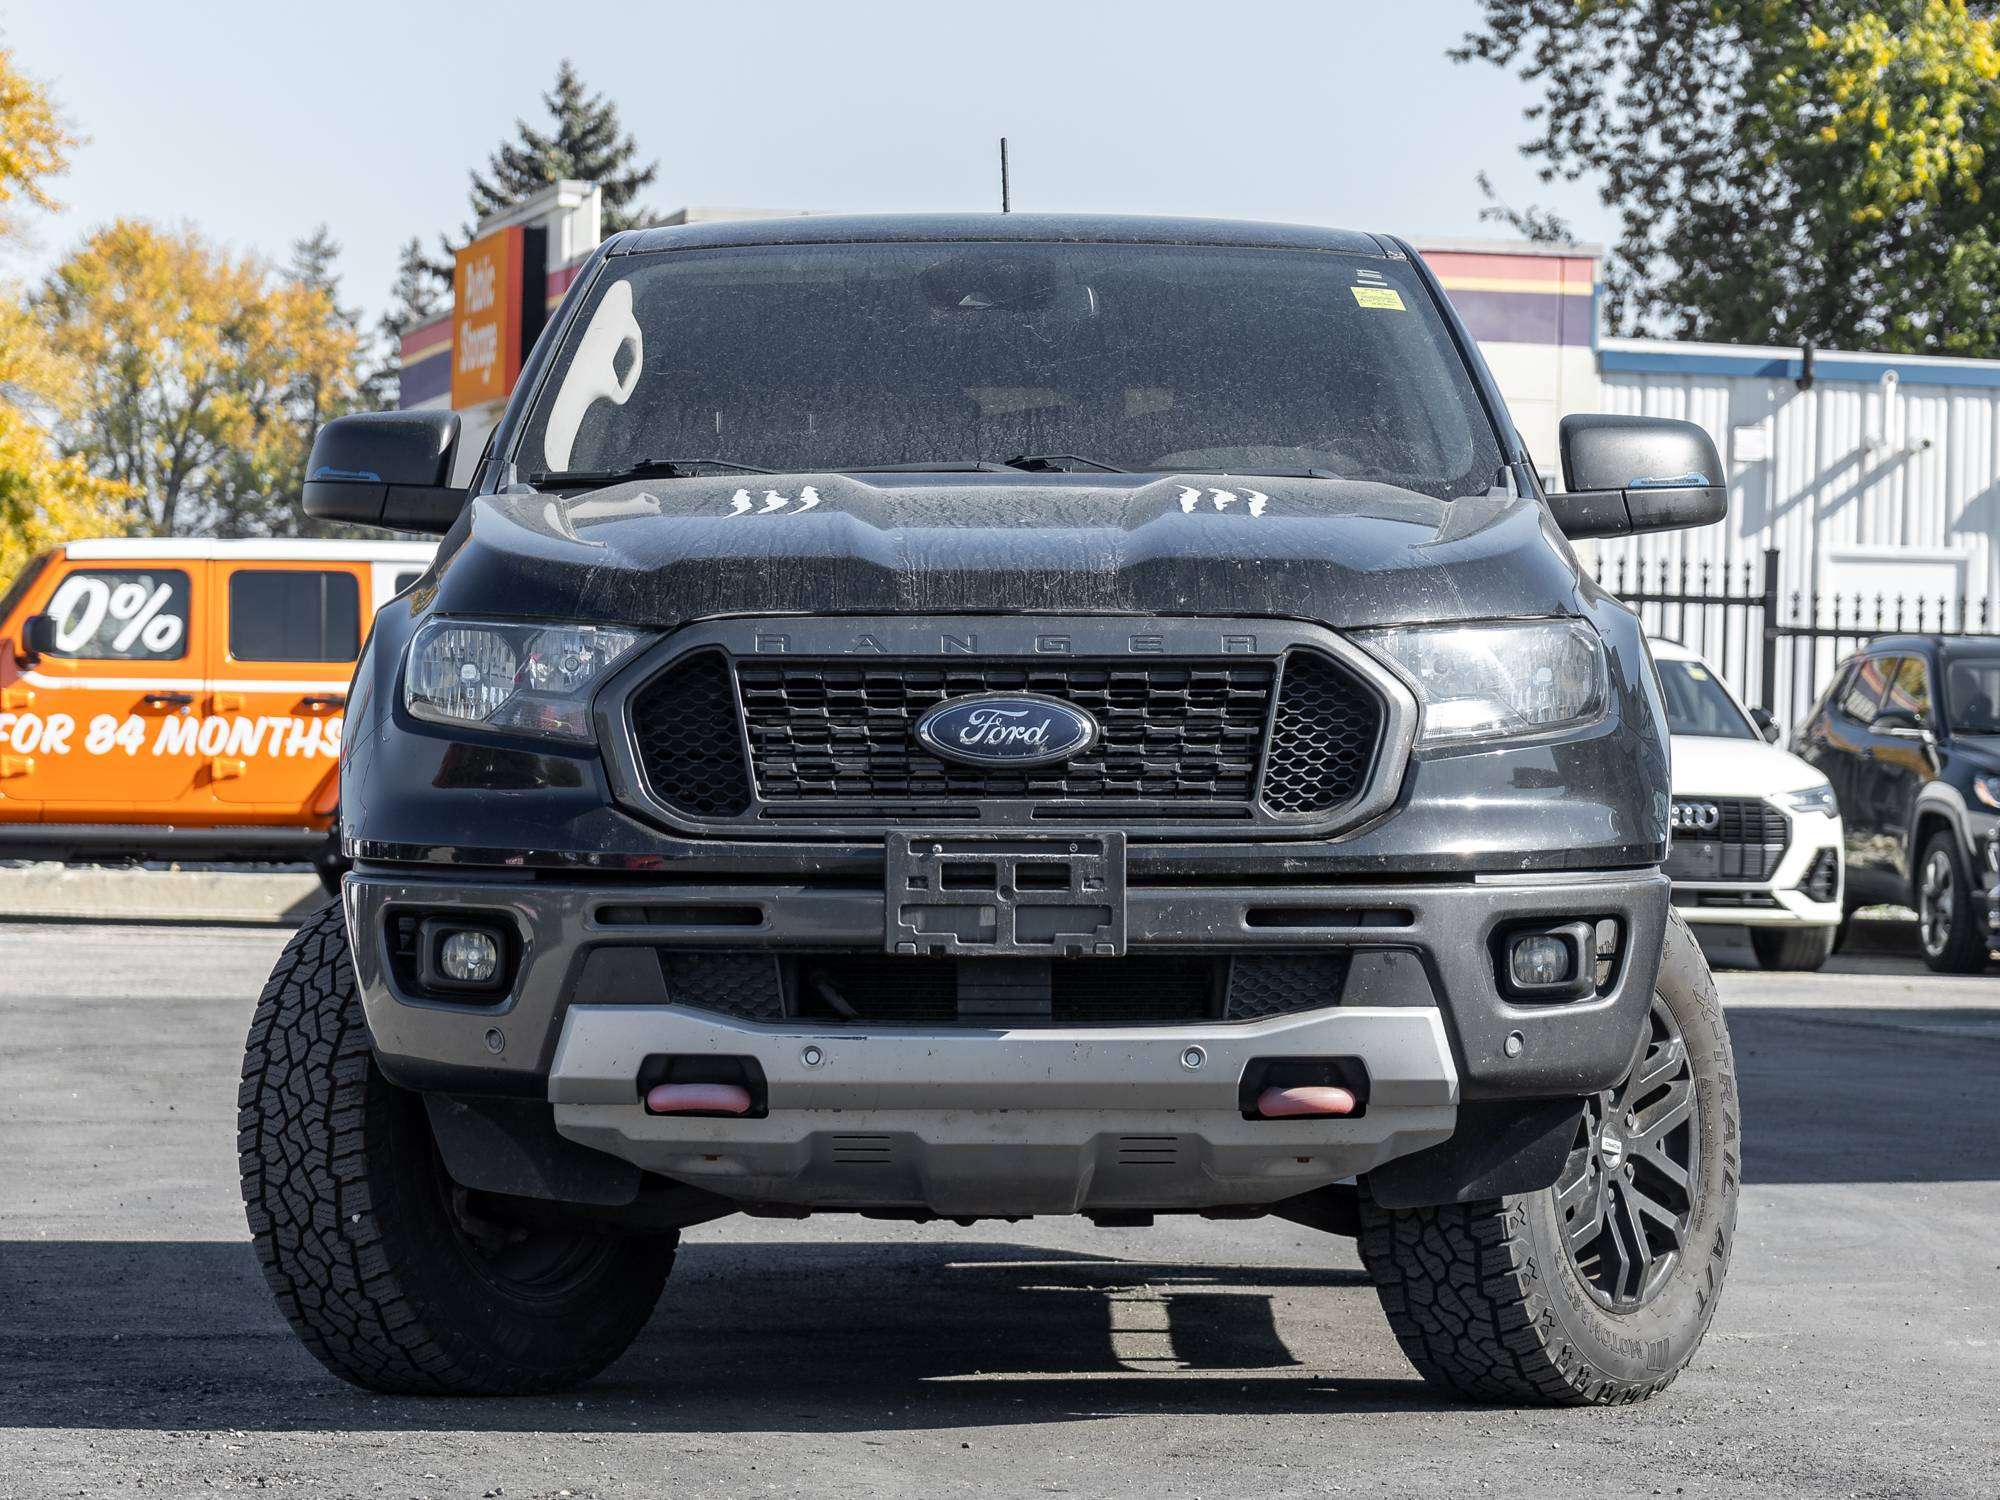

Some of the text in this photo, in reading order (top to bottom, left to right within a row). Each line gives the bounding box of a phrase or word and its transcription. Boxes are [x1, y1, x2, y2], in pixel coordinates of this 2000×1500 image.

[47, 575, 183, 653] 0%
[754, 633, 1258, 654] RANGER
[84, 713, 146, 756] 84
[959, 708, 1051, 745] Ford
